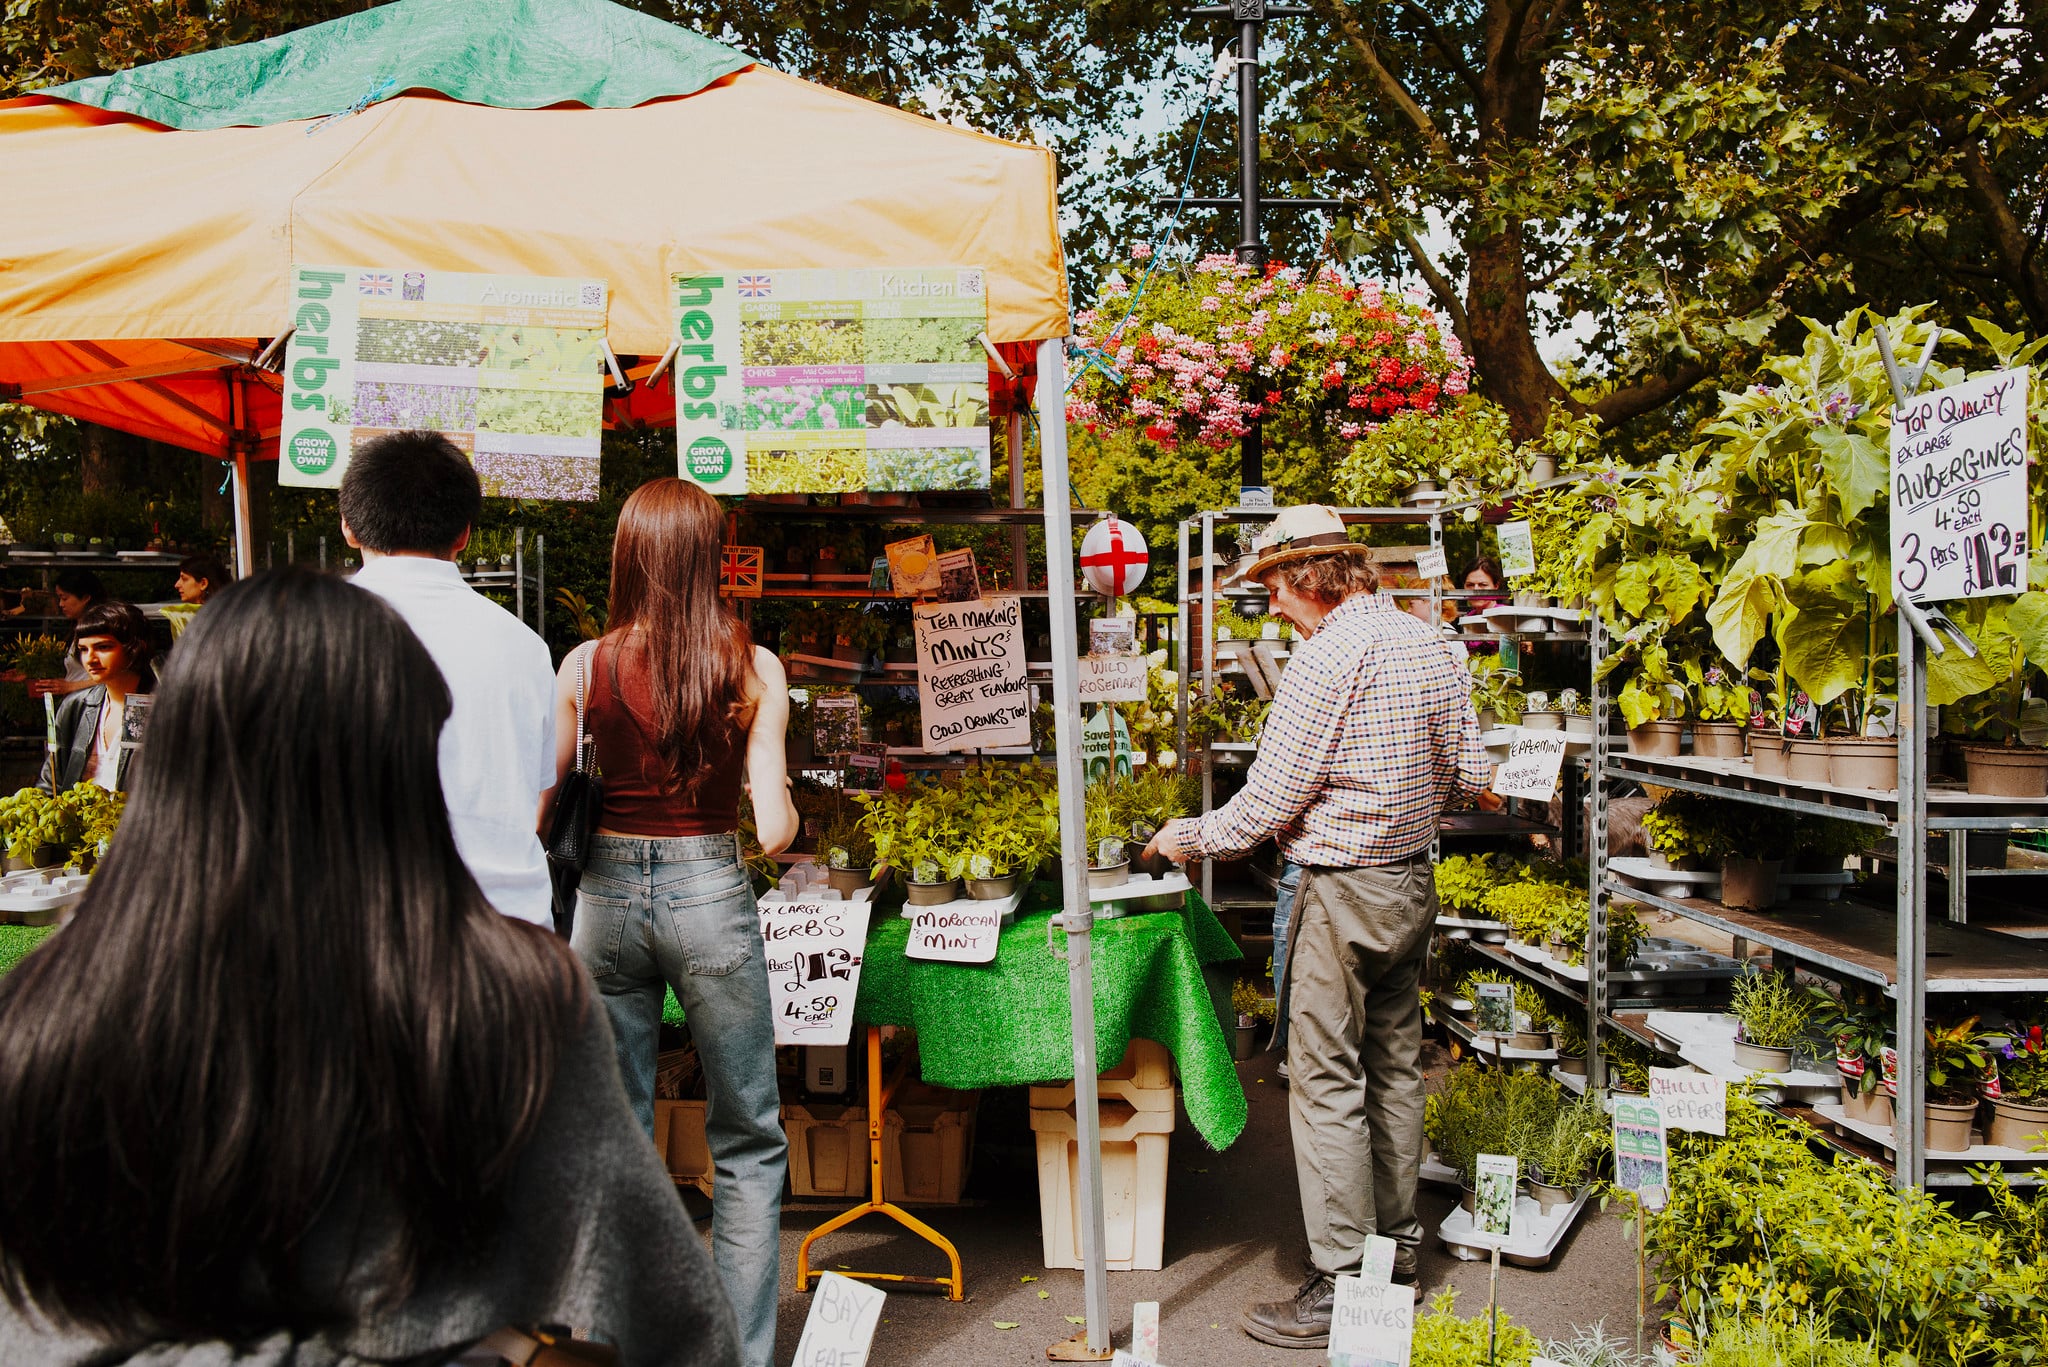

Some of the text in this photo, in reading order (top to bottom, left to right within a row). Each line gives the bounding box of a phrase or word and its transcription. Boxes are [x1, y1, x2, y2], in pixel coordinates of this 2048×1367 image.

[880, 272, 953, 296] Kitchen
[480, 281, 576, 307] Aromatic
[745, 304, 781, 312] GARDEN
[760, 312, 781, 320] MINT
[291, 271, 346, 411] herbs
[679, 277, 727, 420] herbs
[748, 369, 776, 377] CHIVES
[294, 437, 331, 447] GROW
[296, 447, 328, 457] YOUR
[297, 456, 326, 465] OWN
[691, 447, 726, 456] GROW
[694, 456, 724, 465] YOUR
[694, 464, 724, 474] OWN
[1897, 427, 2024, 507] AUBERGINES
[1954, 514, 1982, 532] EACH
[1899, 532, 1927, 593] 3
[931, 633, 1007, 664] MINTS
[1091, 661, 1128, 674] WILD
[935, 675, 1028, 708] GREAT FLAVOUR
[1079, 674, 1145, 695] ROSEMARY
[930, 723, 962, 741] COLD
[964, 708, 1009, 730] DRINKS
[917, 909, 998, 928] MOROCCAN
[924, 933, 981, 950] MINT
[805, 1011, 833, 1022] EACH
[1650, 1077, 1710, 1095] CHILLI
[1656, 1096, 1724, 1121] EPPERS
[819, 1279, 871, 1341] BAY
[1339, 1305, 1407, 1329] CHIVES
